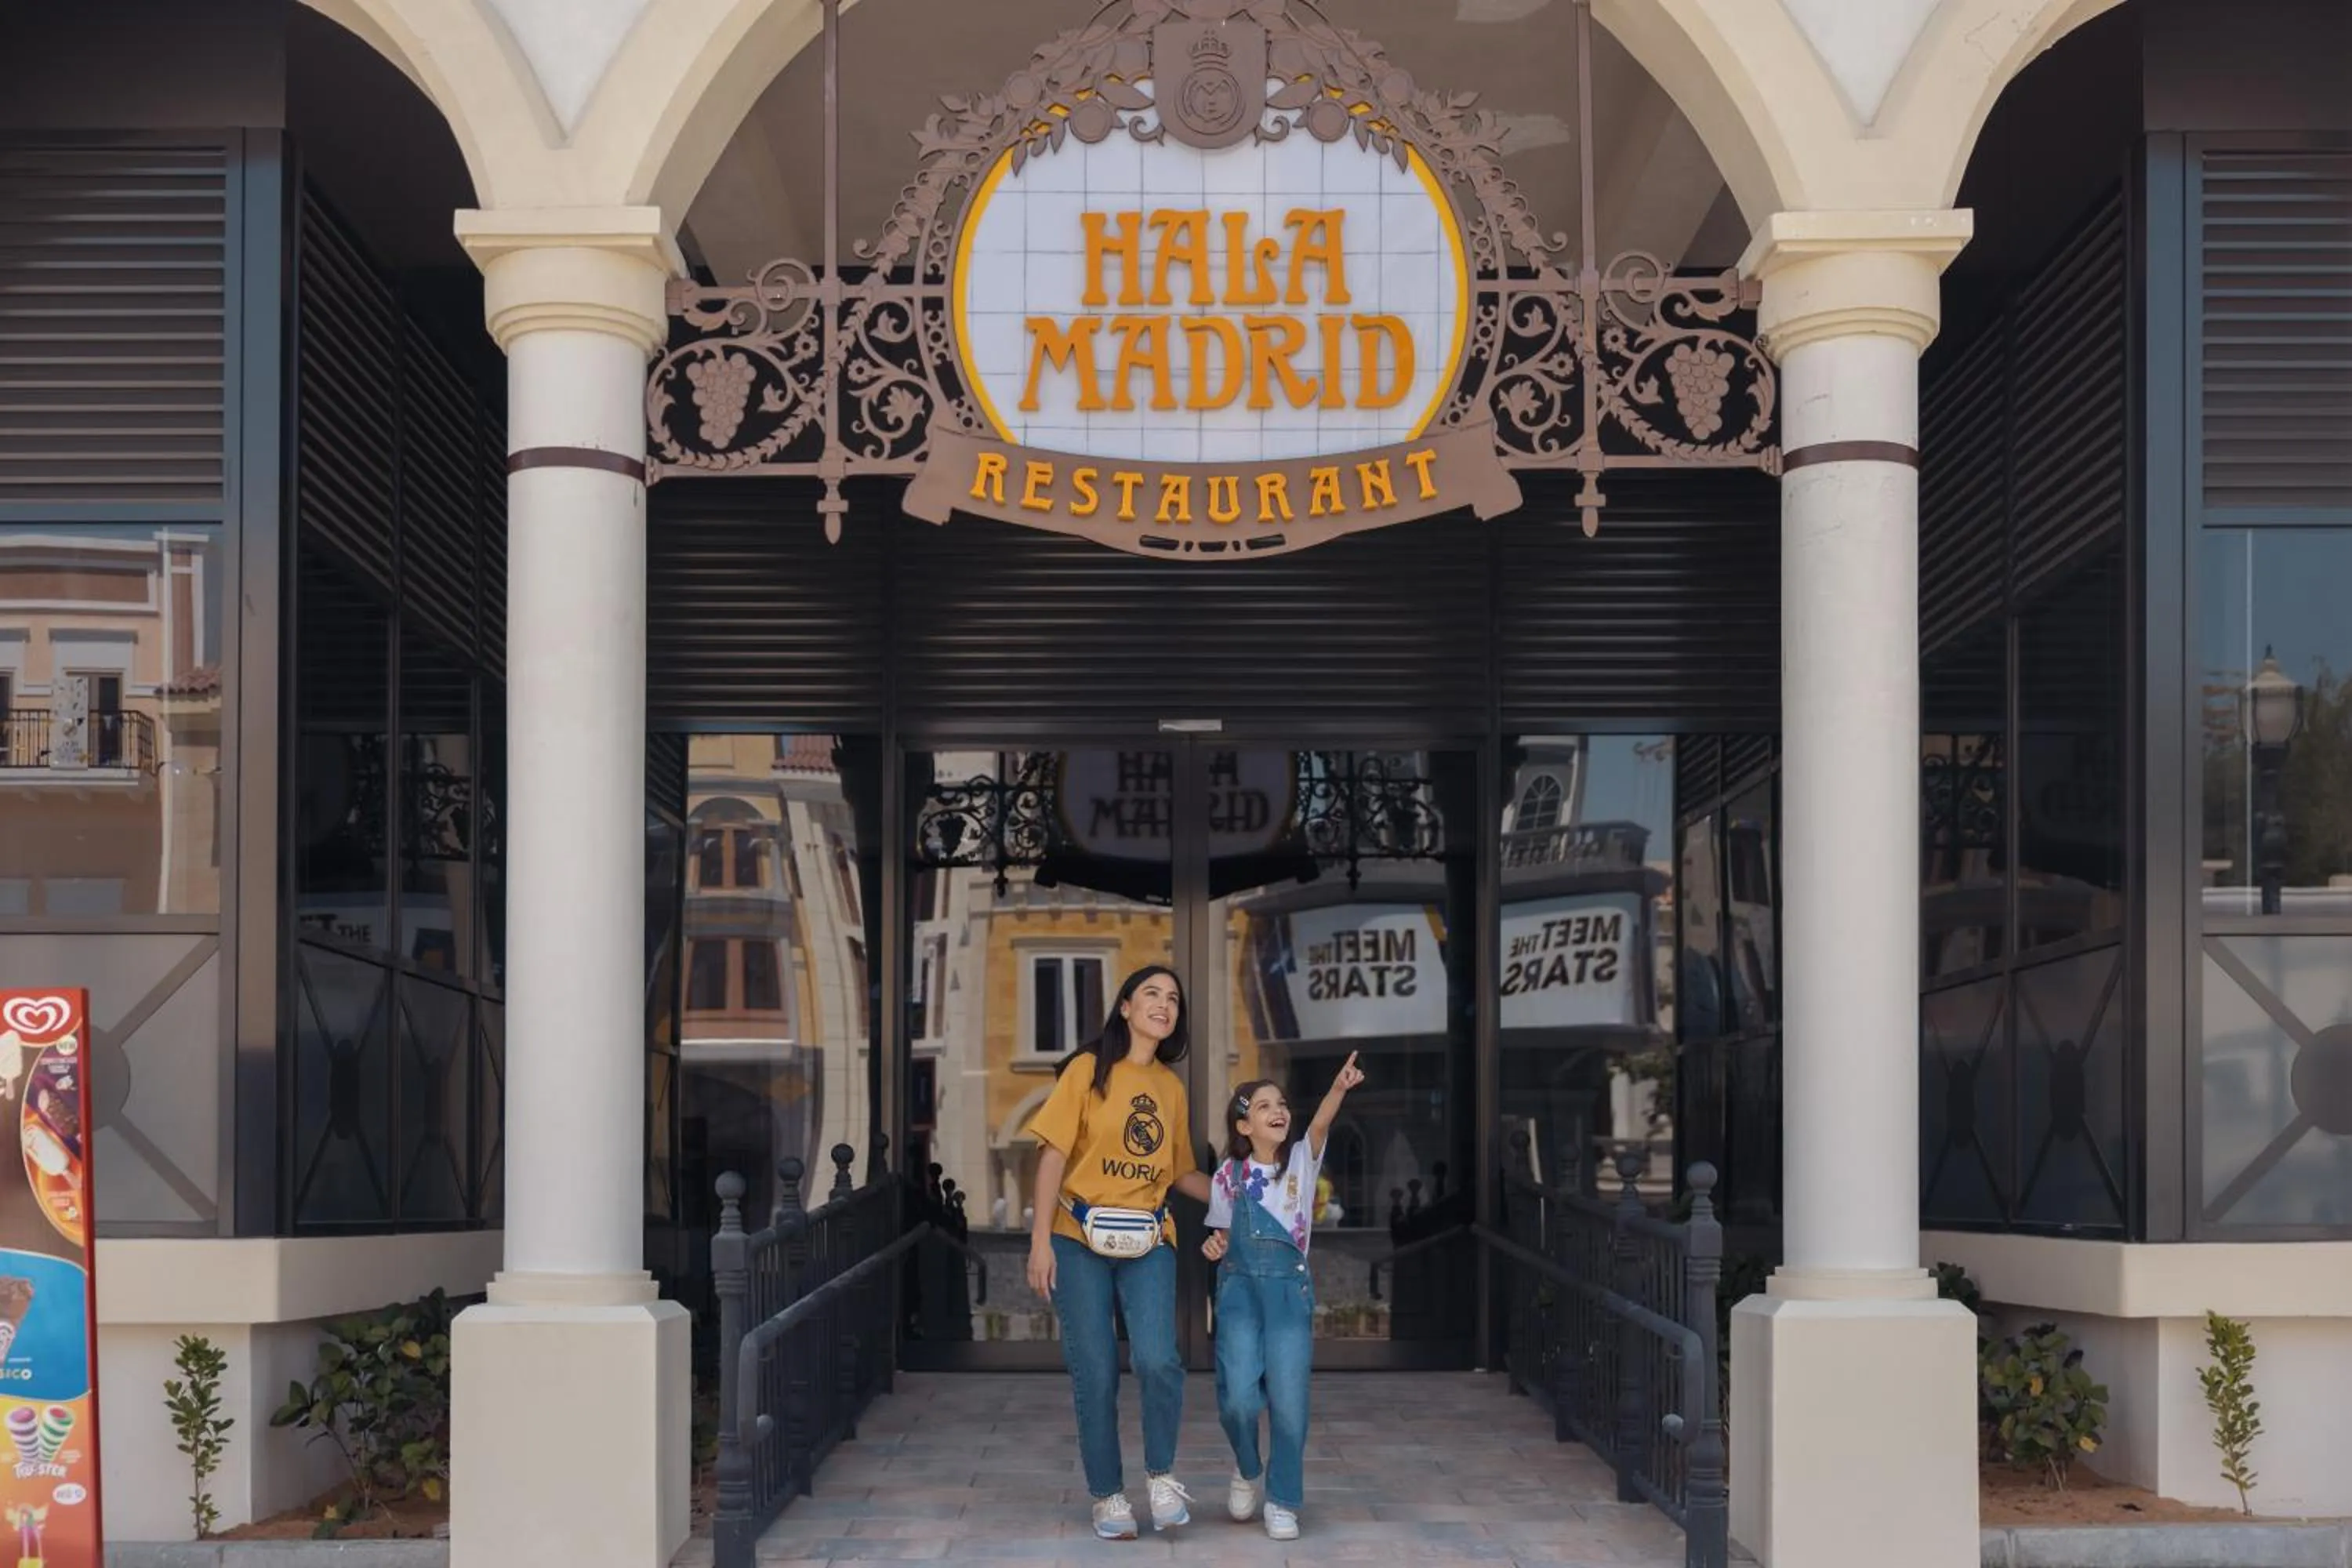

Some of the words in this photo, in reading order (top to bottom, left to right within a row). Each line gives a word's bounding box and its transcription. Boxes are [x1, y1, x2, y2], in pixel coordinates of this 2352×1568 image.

[1080, 208, 1352, 307] HALA
[1018, 315, 1415, 412] MADRID
[969, 448, 1438, 524] RESTAURANT
